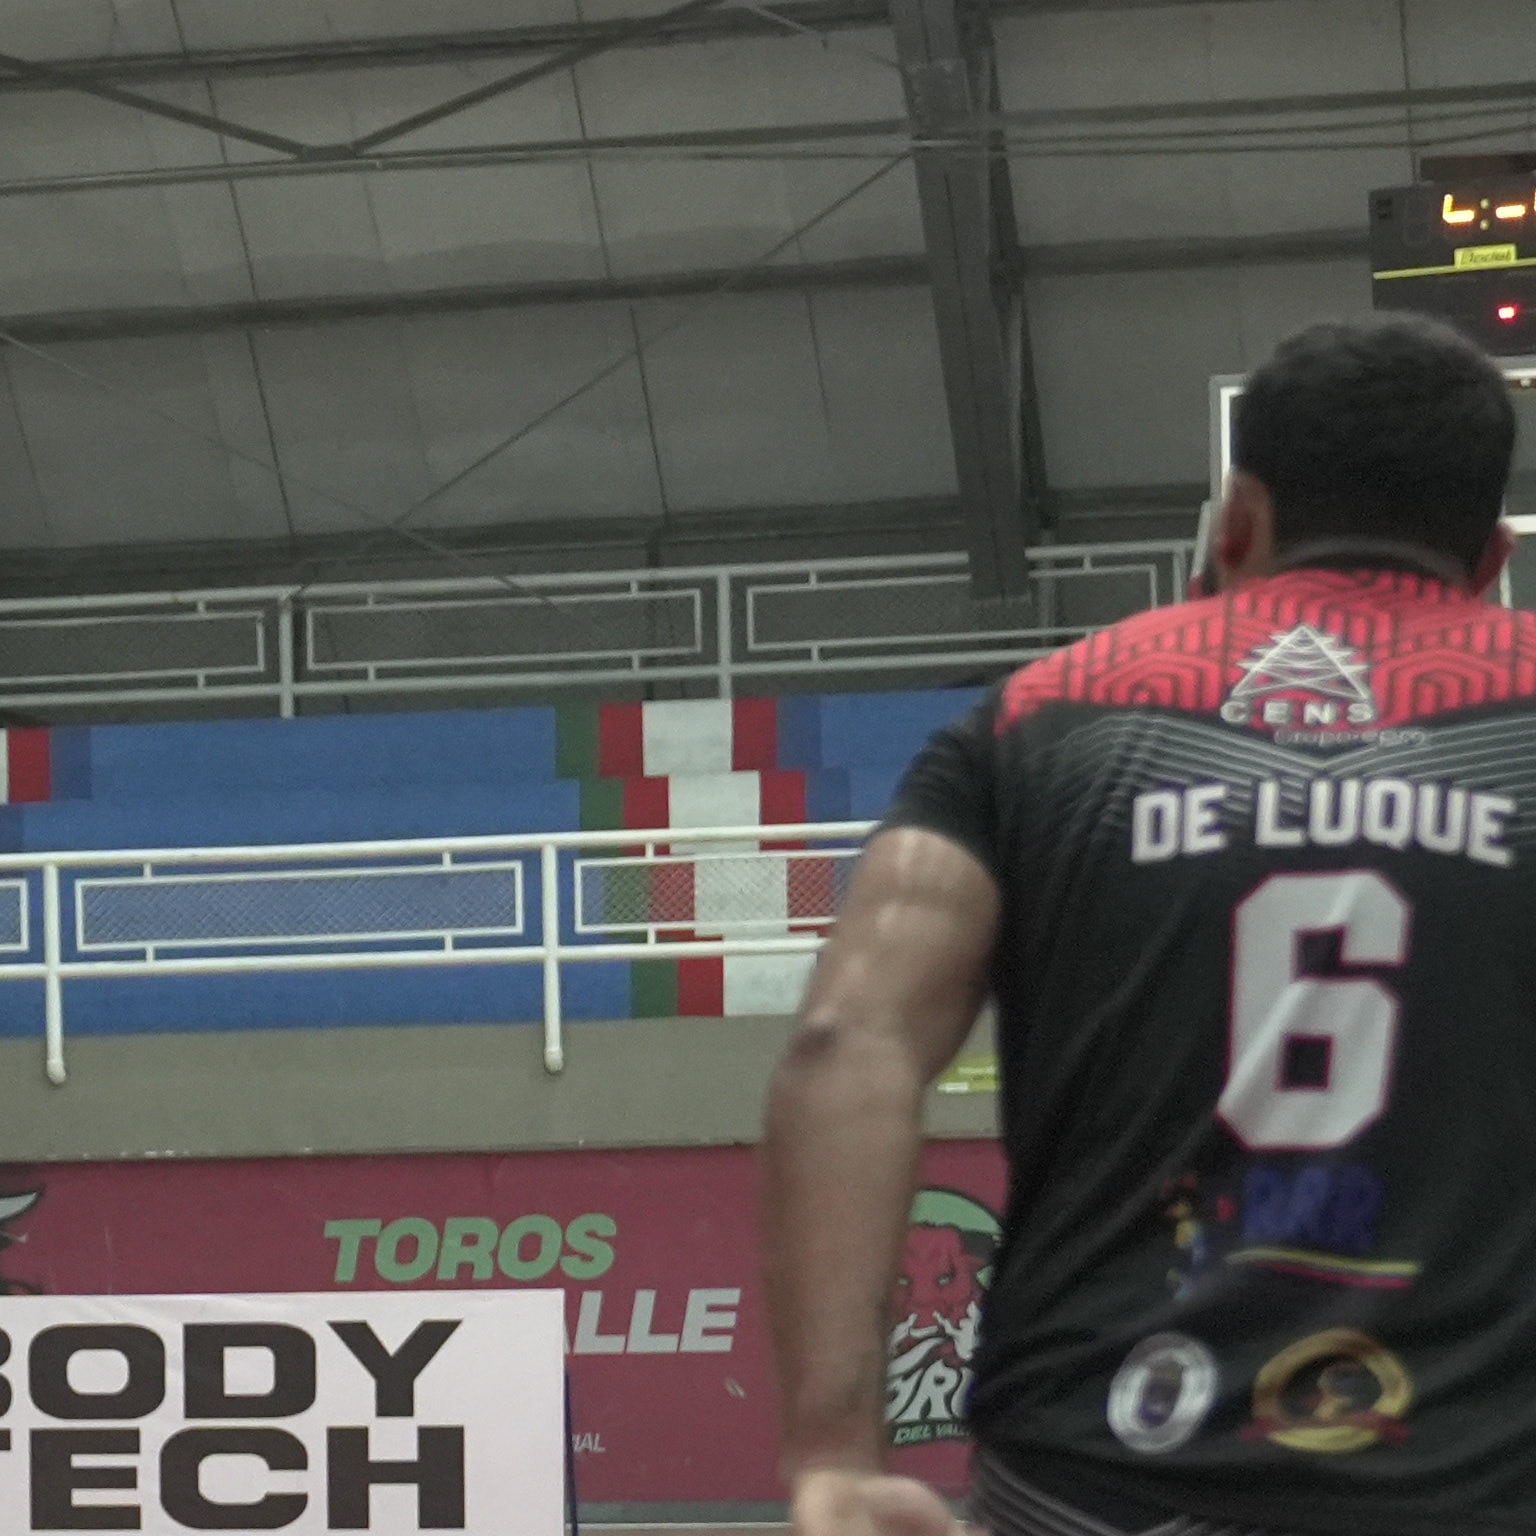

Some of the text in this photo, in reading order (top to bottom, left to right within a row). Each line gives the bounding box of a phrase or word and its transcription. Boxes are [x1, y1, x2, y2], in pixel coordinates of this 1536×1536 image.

[1220, 700, 1376, 725] CENS
[1131, 777, 1518, 868] DE LUQUE
[1217, 869, 1411, 1150] 6
[324, 1212, 618, 1283] TOROS
[564, 1287, 741, 1354] LLE
